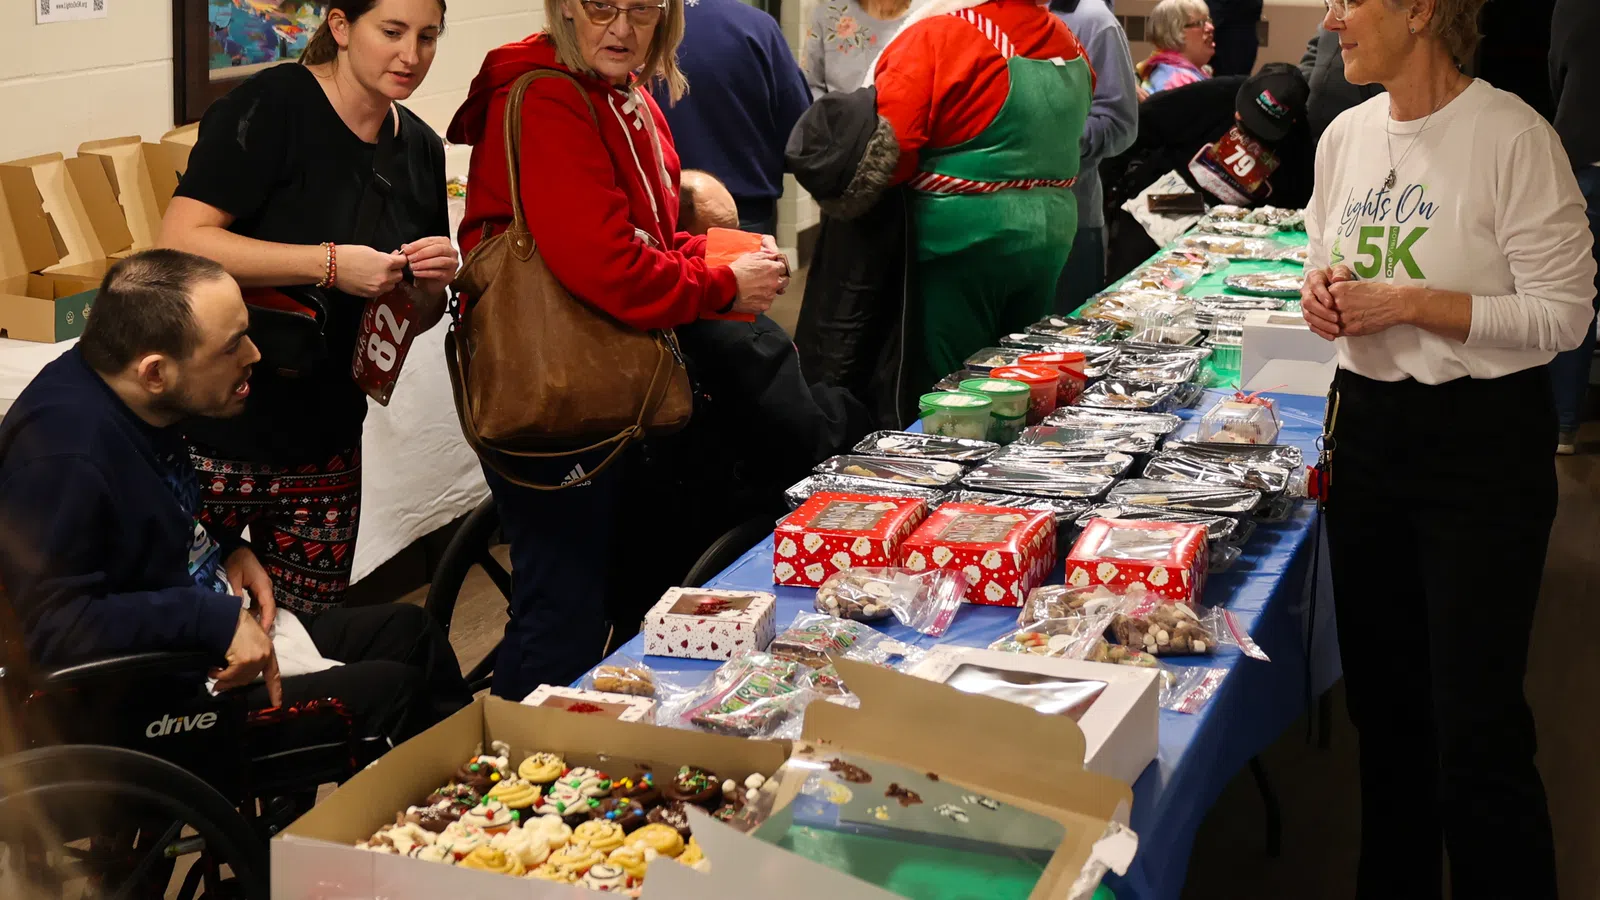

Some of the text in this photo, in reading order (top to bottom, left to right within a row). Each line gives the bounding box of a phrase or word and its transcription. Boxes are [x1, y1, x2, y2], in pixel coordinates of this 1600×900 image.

[1223, 144, 1256, 177] 79
[1340, 183, 1440, 238] Lights On
[1353, 225, 1430, 280] 5K
[367, 303, 411, 373] 82
[145, 711, 218, 739] drive
